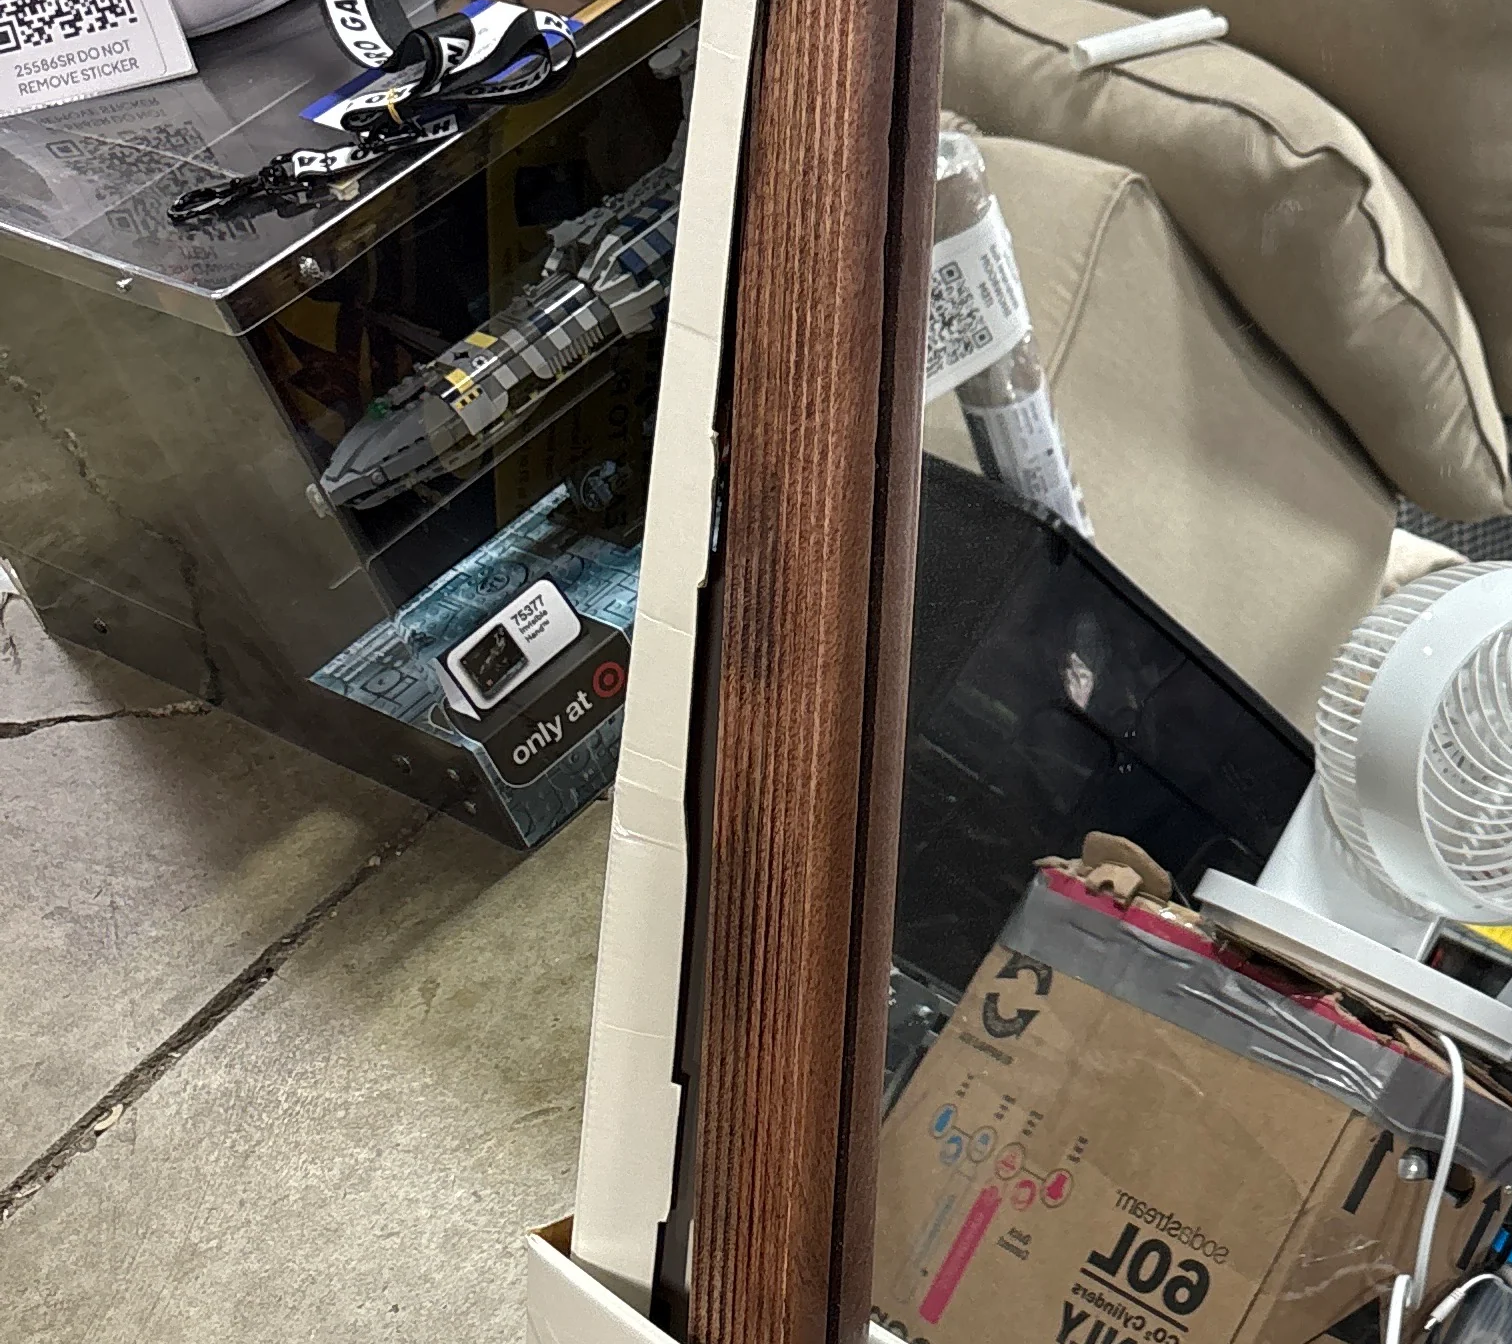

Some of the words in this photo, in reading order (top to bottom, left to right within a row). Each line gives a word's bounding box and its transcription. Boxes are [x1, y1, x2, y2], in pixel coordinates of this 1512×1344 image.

[14, 53, 77, 78] 25586SR
[77, 47, 101, 64] DO
[101, 38, 132, 58] NOT
[18, 71, 81, 96] REMOVE
[82, 57, 140, 82] STICKER
[510, 594, 544, 626] 75377
[512, 714, 564, 766] only
[565, 689, 593, 723] at
